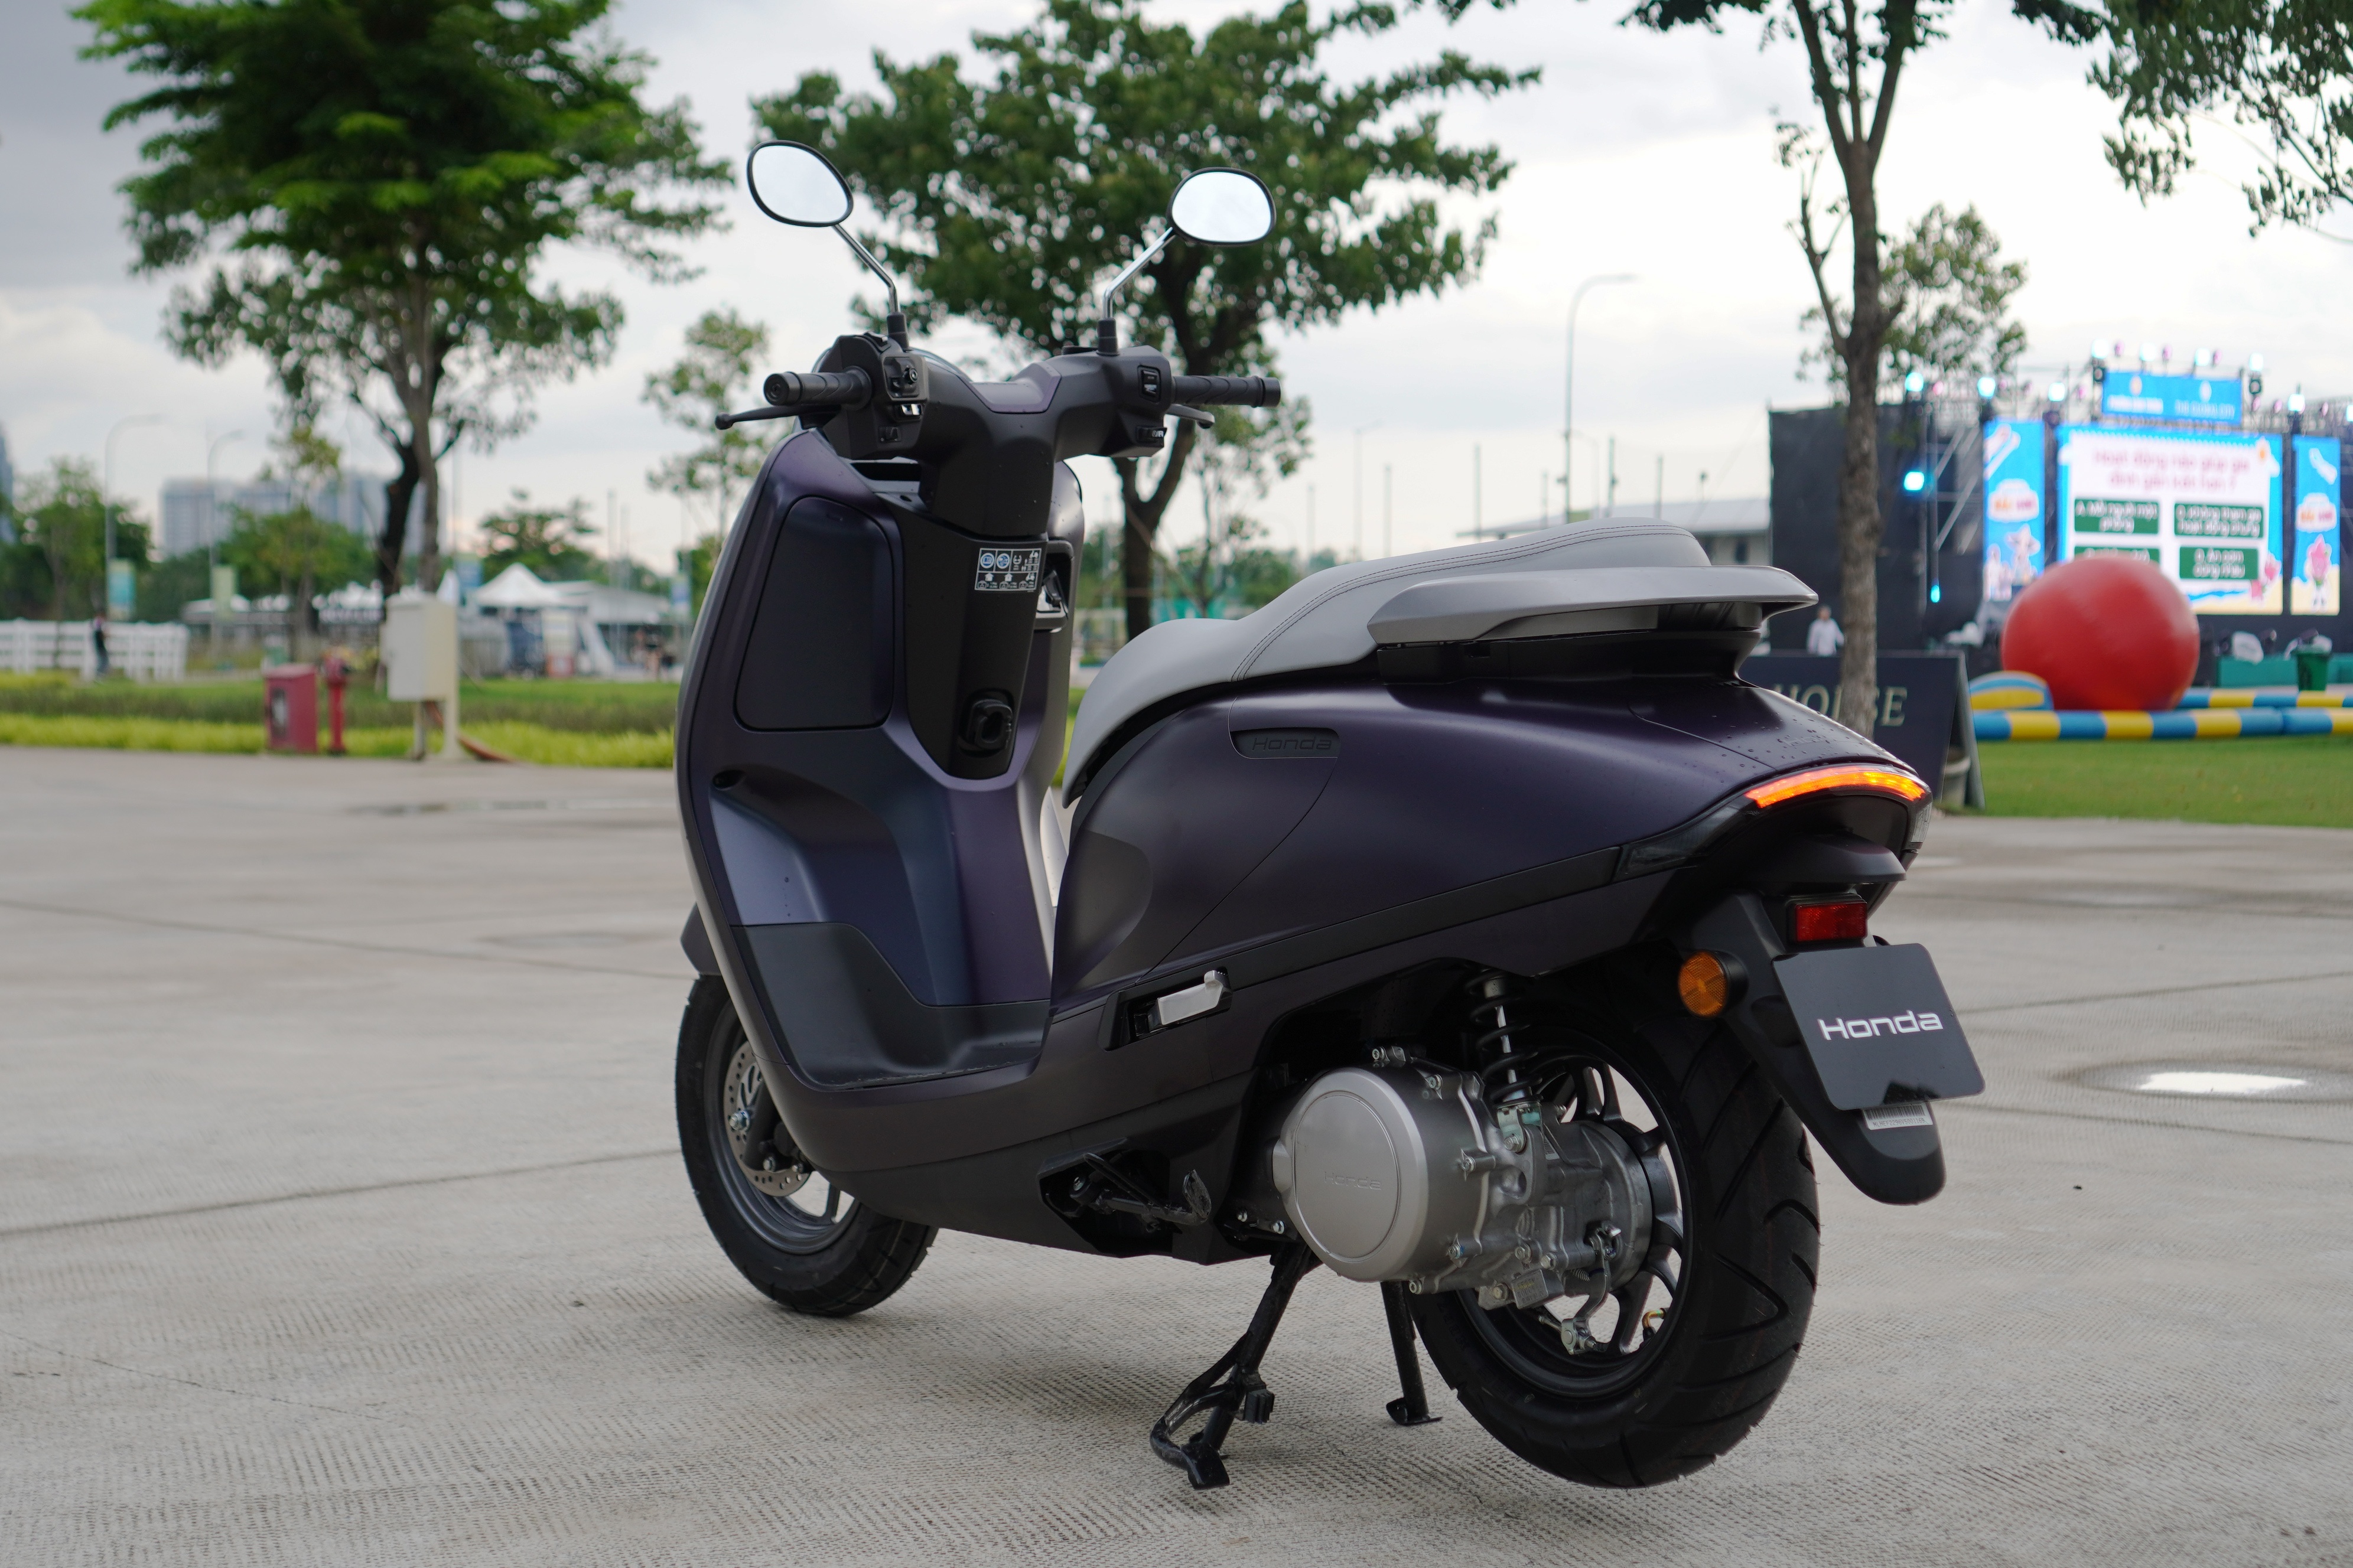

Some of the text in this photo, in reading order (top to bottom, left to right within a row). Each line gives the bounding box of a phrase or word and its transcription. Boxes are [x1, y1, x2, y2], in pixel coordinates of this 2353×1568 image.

[1252, 736, 1332, 751] Honda
[1817, 1009, 1944, 1041] Honda
[1323, 1171, 1383, 1191] Honda
